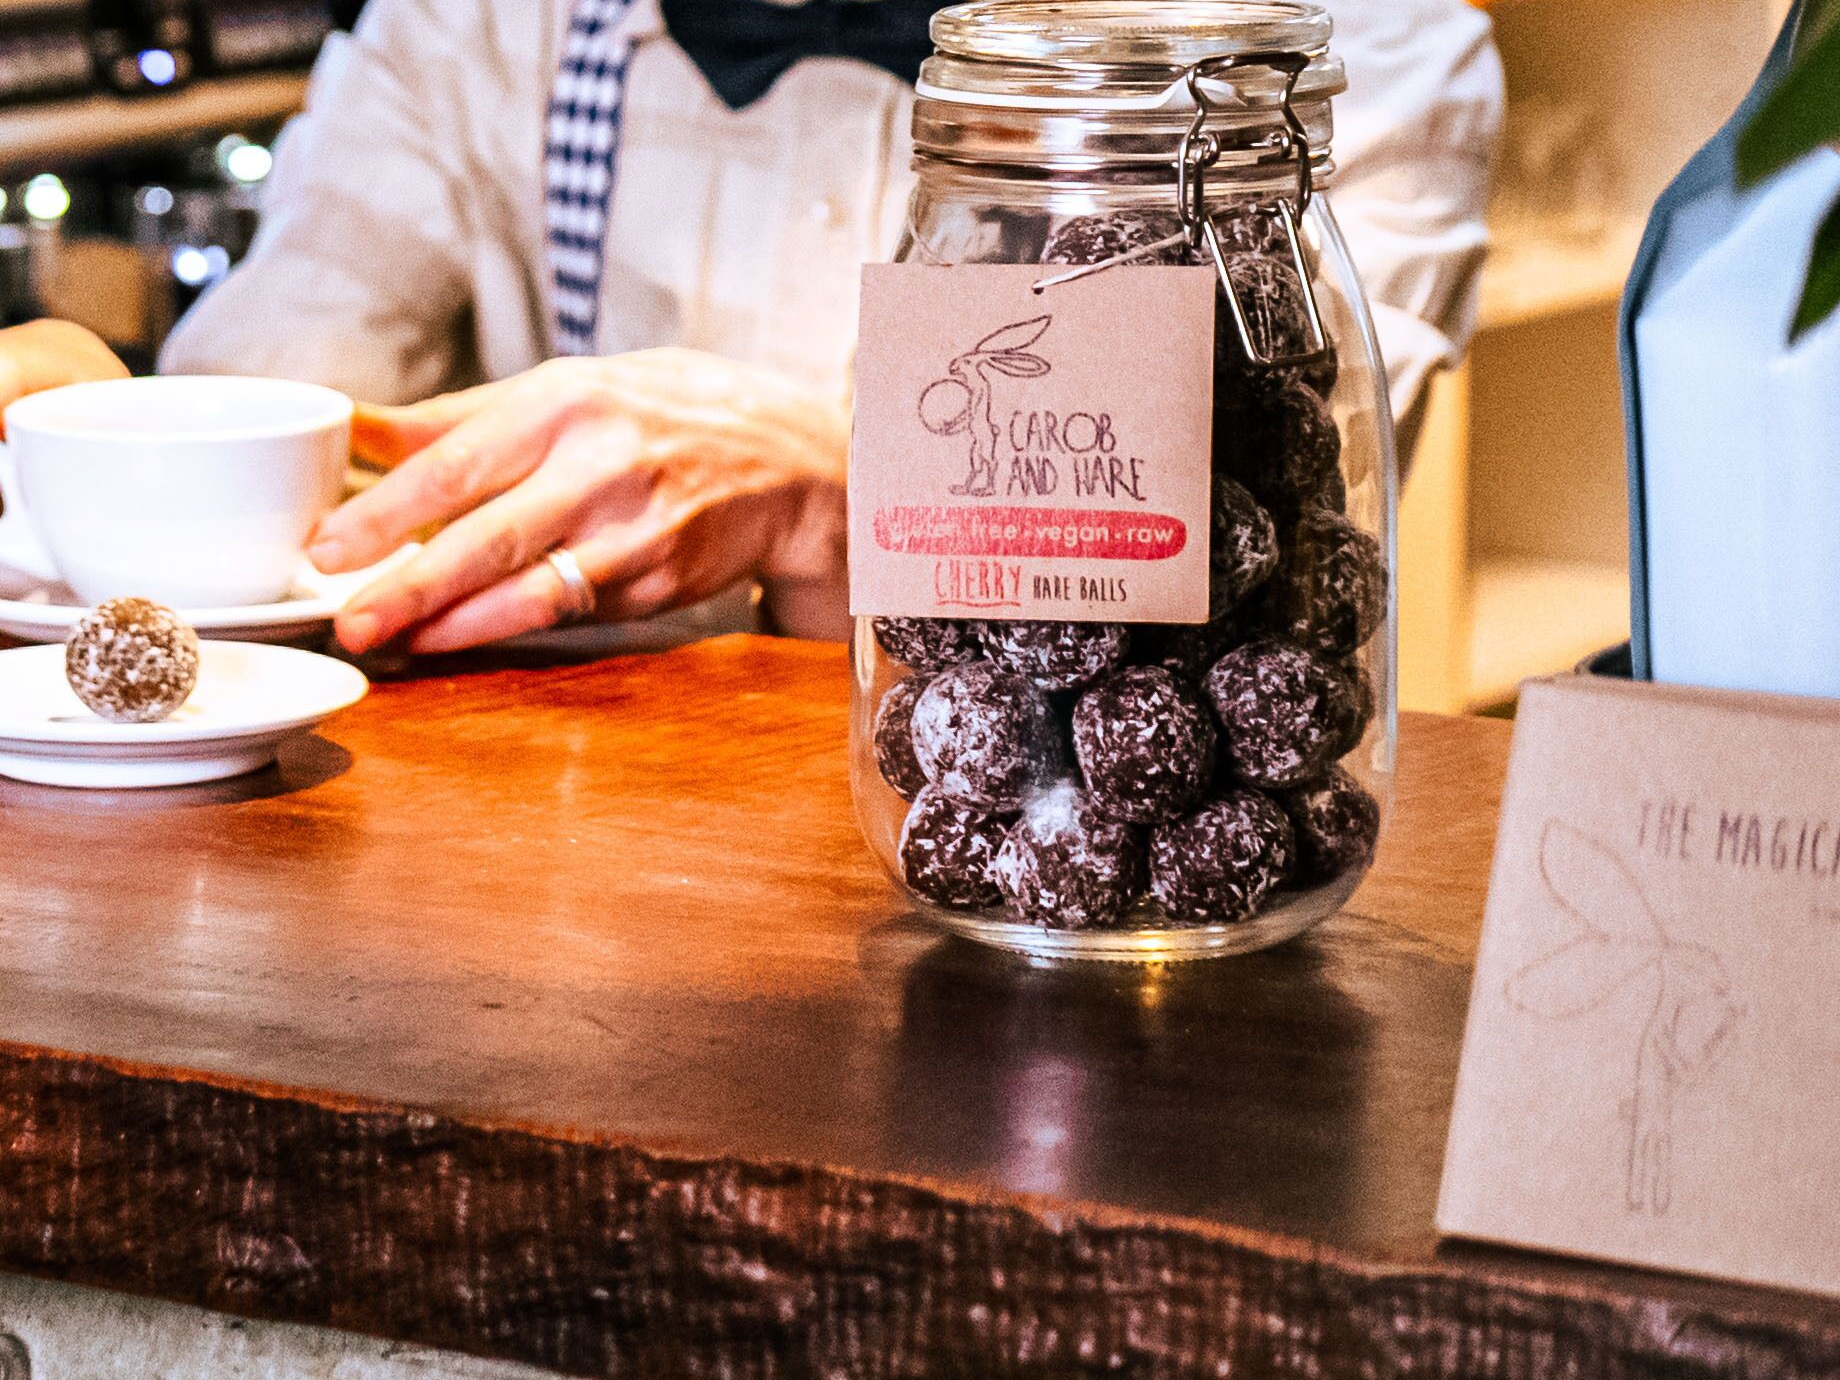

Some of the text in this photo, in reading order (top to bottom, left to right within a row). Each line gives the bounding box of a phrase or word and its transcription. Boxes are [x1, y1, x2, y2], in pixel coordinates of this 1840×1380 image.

[1009, 409, 1117, 455] CAROB
[1006, 455, 1148, 502] AND HARE
[971, 514, 1018, 541] free
[1034, 524, 1110, 549] vegan
[1126, 527, 1175, 544] raw
[933, 559, 1128, 603] CHERRY HARE BALLS
[1637, 796, 1697, 861] THE
